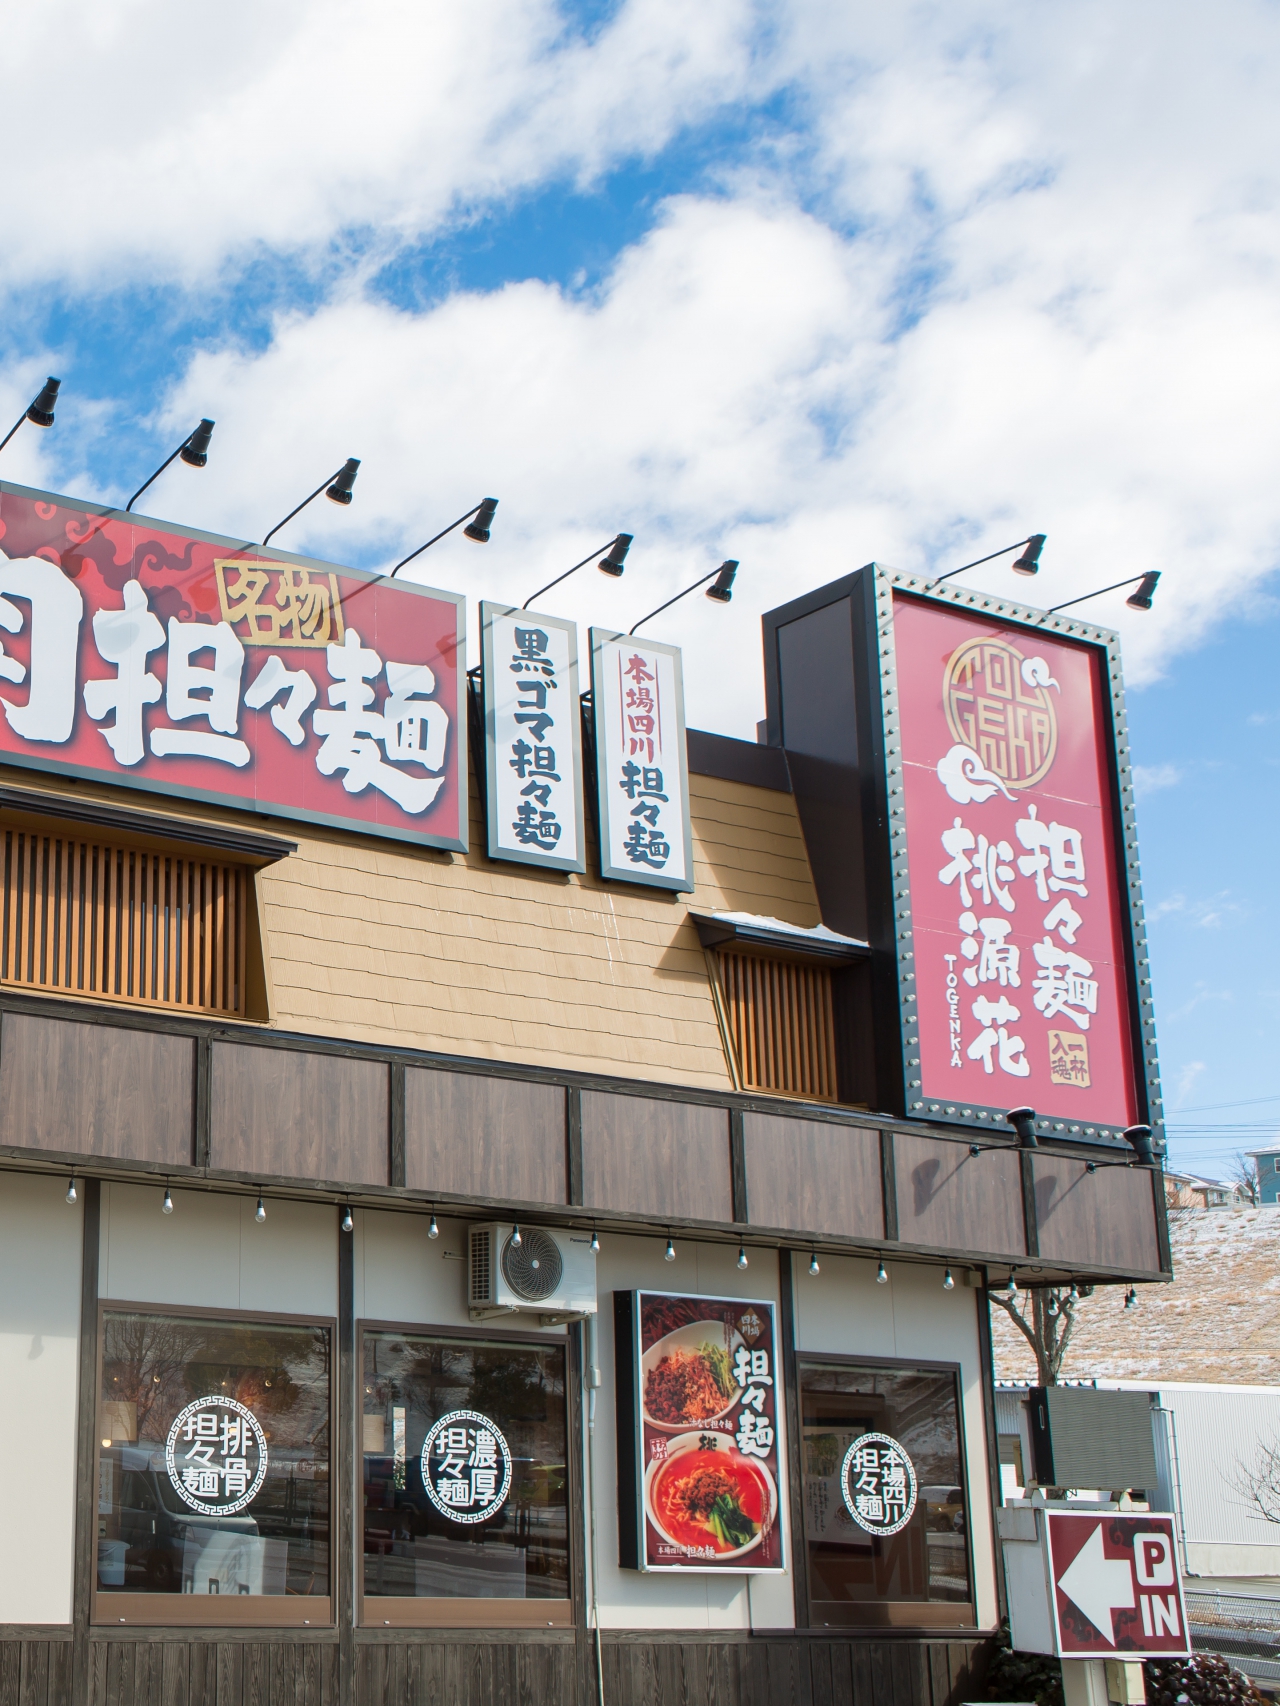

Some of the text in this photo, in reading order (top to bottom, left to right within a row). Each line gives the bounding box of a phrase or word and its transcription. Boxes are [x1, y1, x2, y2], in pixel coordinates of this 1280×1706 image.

[226, 565, 332, 643] 名物
[508, 626, 562, 851] 黒ゴマ担々麺
[938, 817, 1030, 1077] 桃源花
[1015, 804, 1098, 1030] 担々麺
[943, 953, 963, 1068] TOGENKA
[732, 1344, 774, 1459] 担々麺
[181, 1413, 219, 1498] 担々麺
[220, 1415, 253, 1498] 排骨
[435, 1427, 470, 1508] 担々麺
[467, 1428, 499, 1508] 濃厚
[852, 1448, 884, 1521] 担々麺
[880, 1447, 906, 1524] 本場四川
[1143, 1540, 1166, 1577] P
[1140, 1594, 1180, 1637] IN
